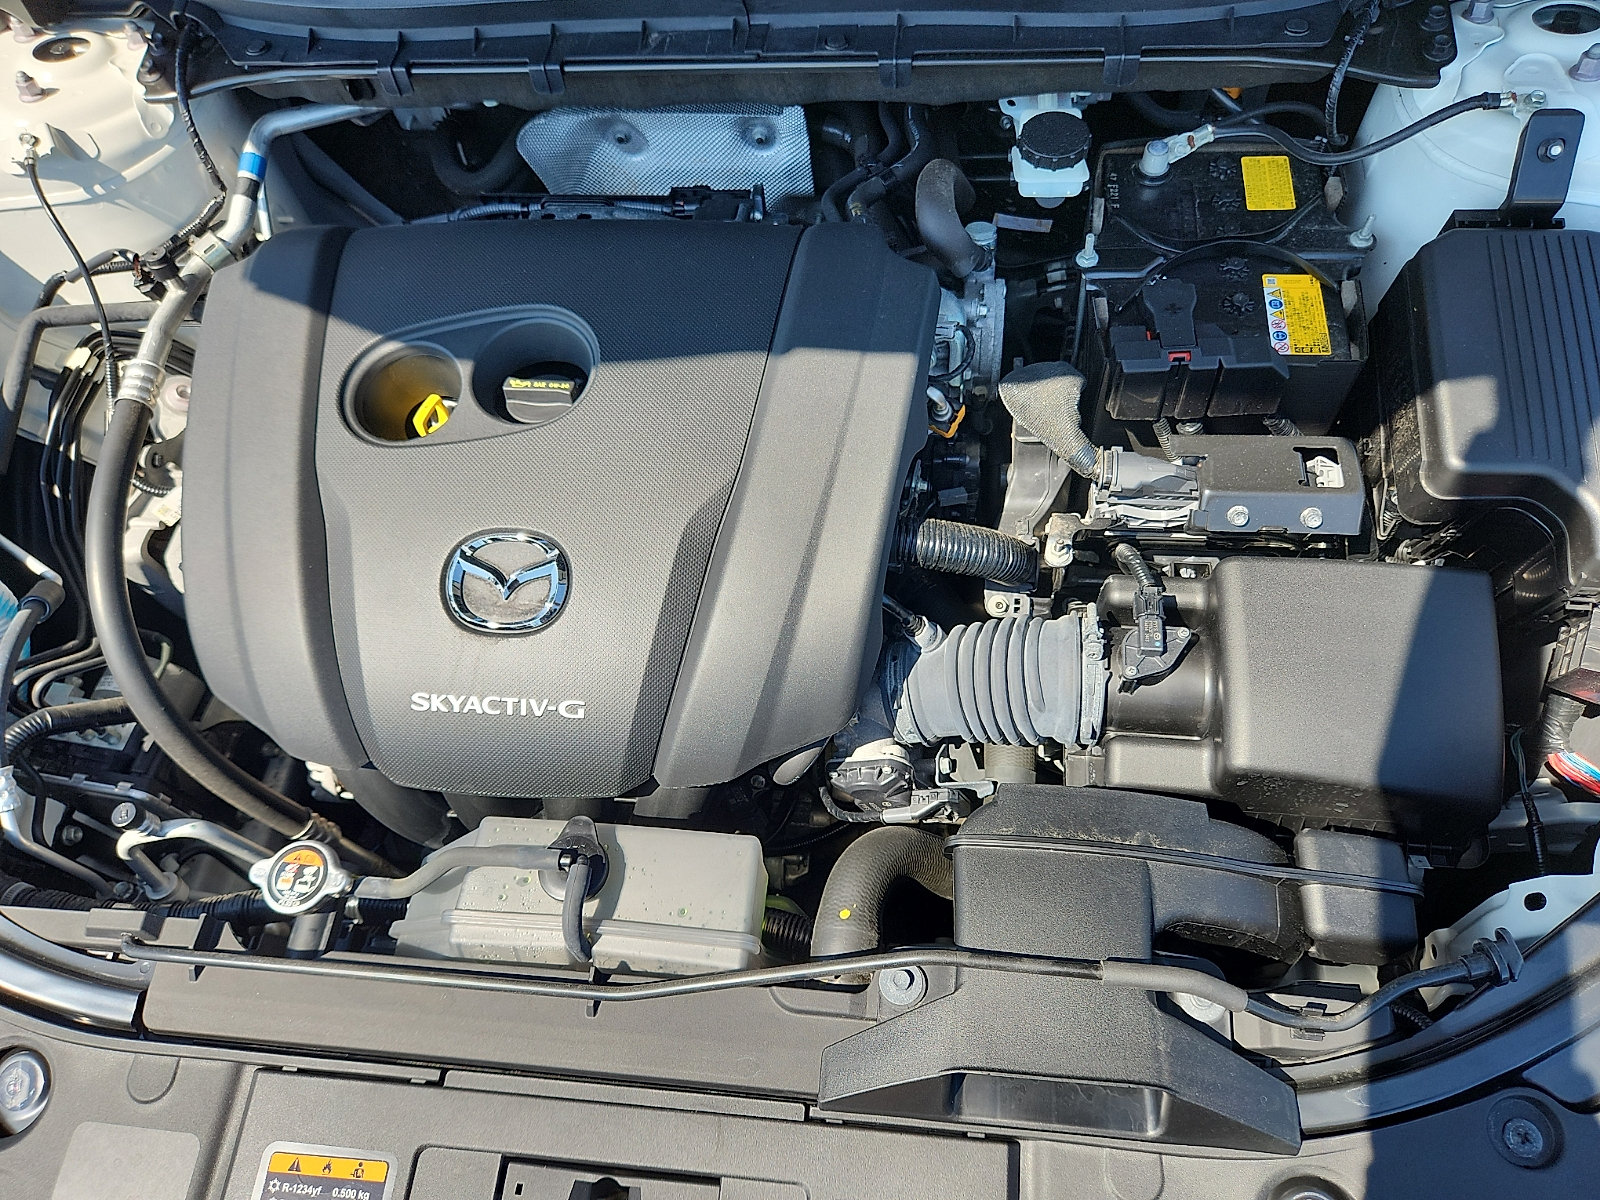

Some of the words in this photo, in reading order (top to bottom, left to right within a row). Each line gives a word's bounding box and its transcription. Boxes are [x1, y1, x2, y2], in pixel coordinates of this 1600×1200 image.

[410, 692, 587, 719] SKYACTIV-G
[281, 1182, 323, 1198] R-1234yf
[332, 1187, 357, 1199] 0.500
[357, 1189, 371, 1200] kg
